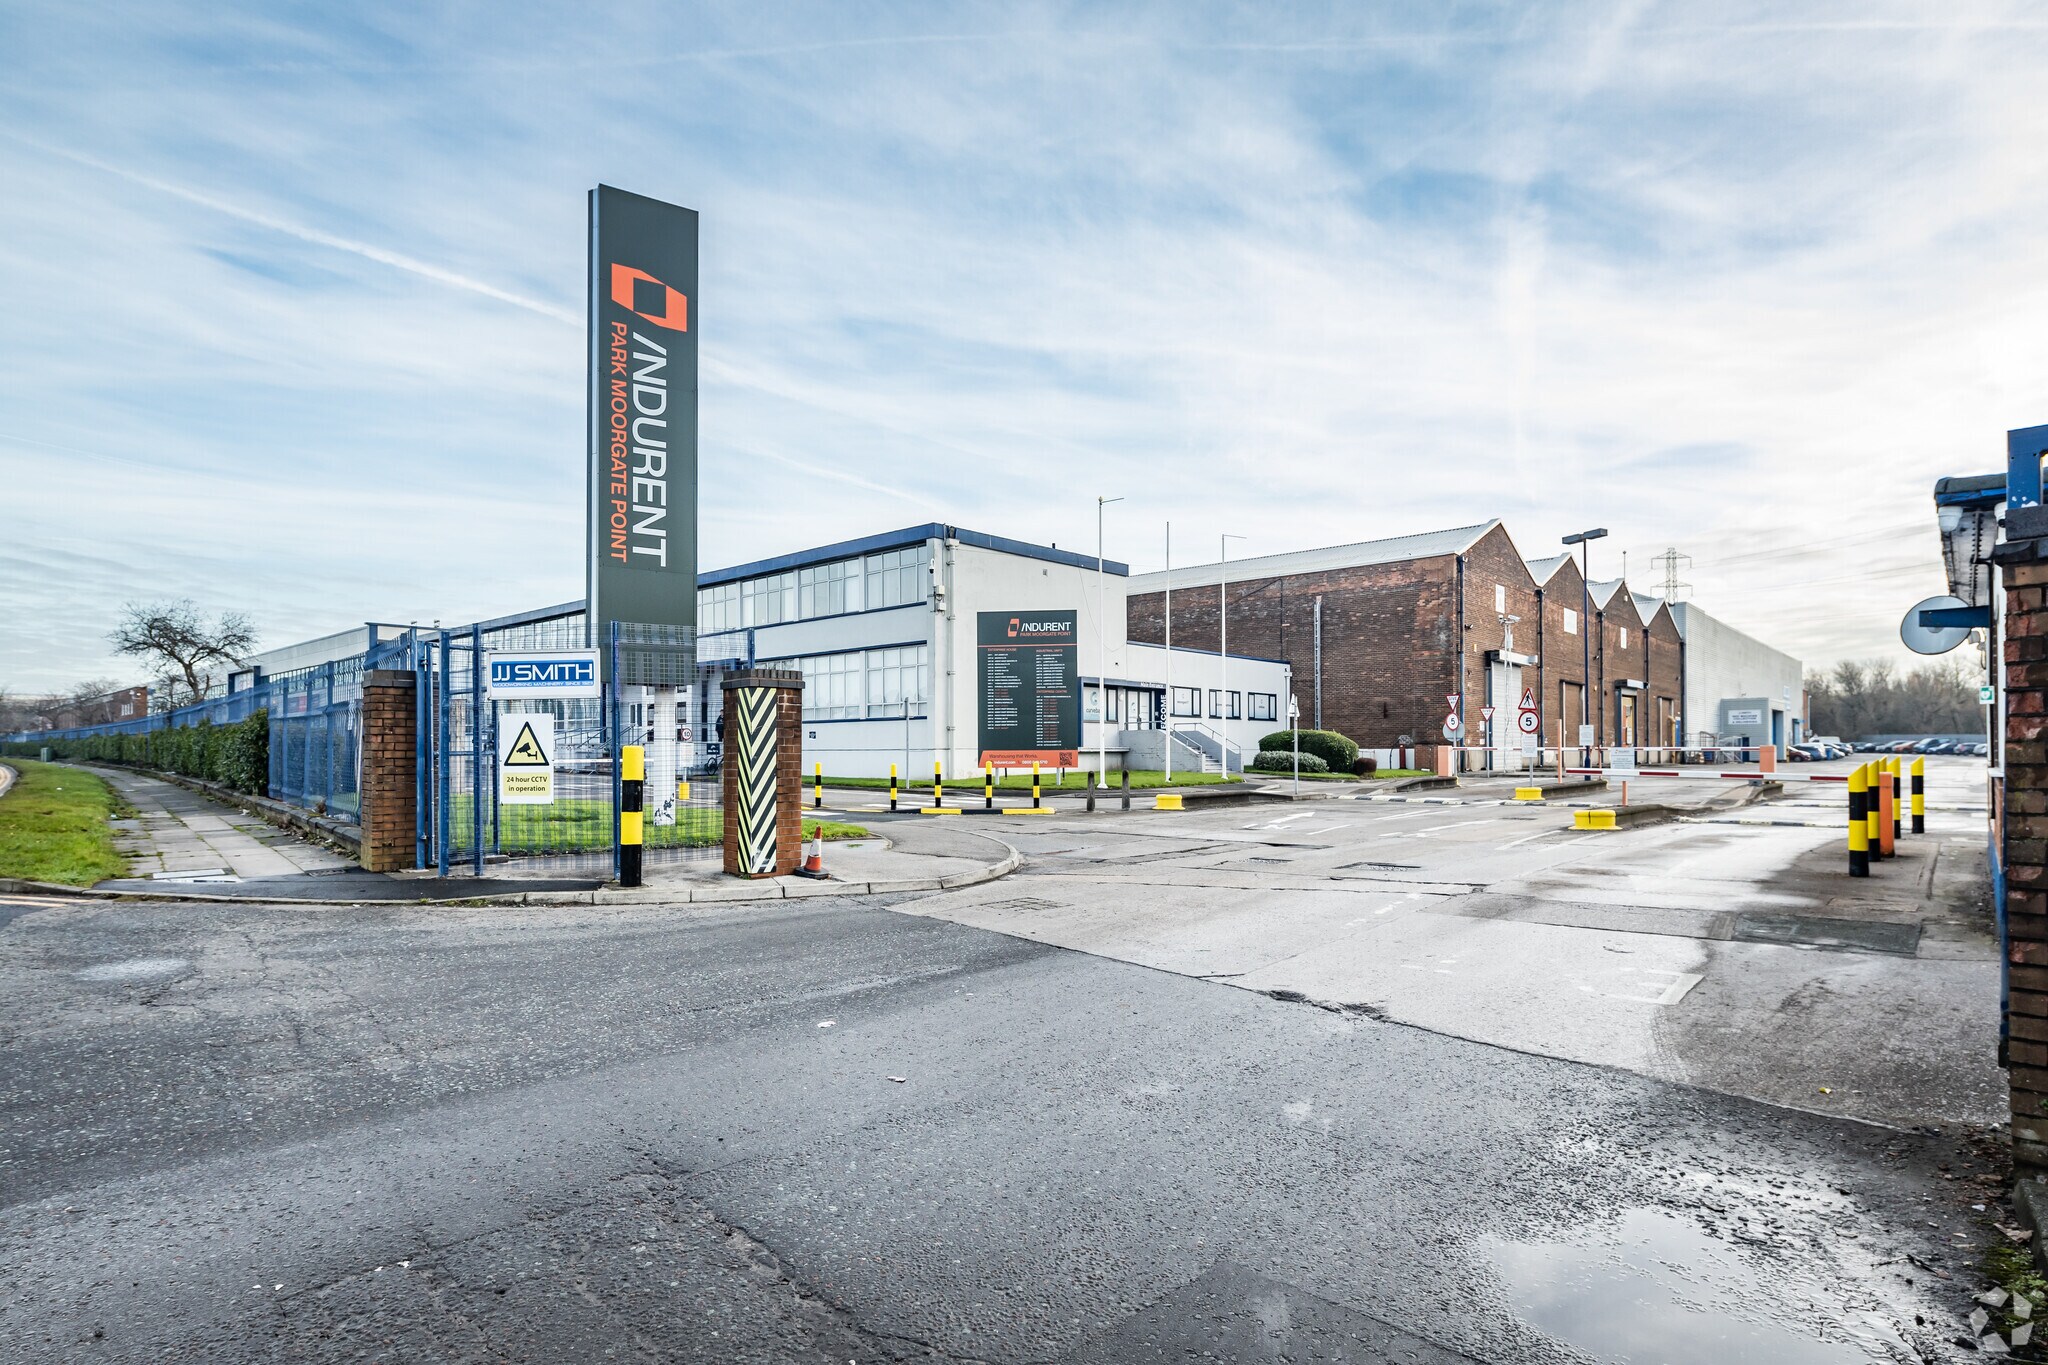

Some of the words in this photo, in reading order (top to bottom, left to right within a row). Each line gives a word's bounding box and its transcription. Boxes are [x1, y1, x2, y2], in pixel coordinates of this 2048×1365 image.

[611, 321, 627, 376] PARK
[611, 379, 627, 496] MOORGATE
[632, 331, 667, 567] INDURENT
[610, 499, 627, 562] POINT
[1021, 622, 1071, 632] INDURENT
[515, 664, 593, 681] SMITH
[1450, 718, 1456, 726] 5
[1525, 717, 1532, 727] 5
[515, 785, 546, 793] operation
